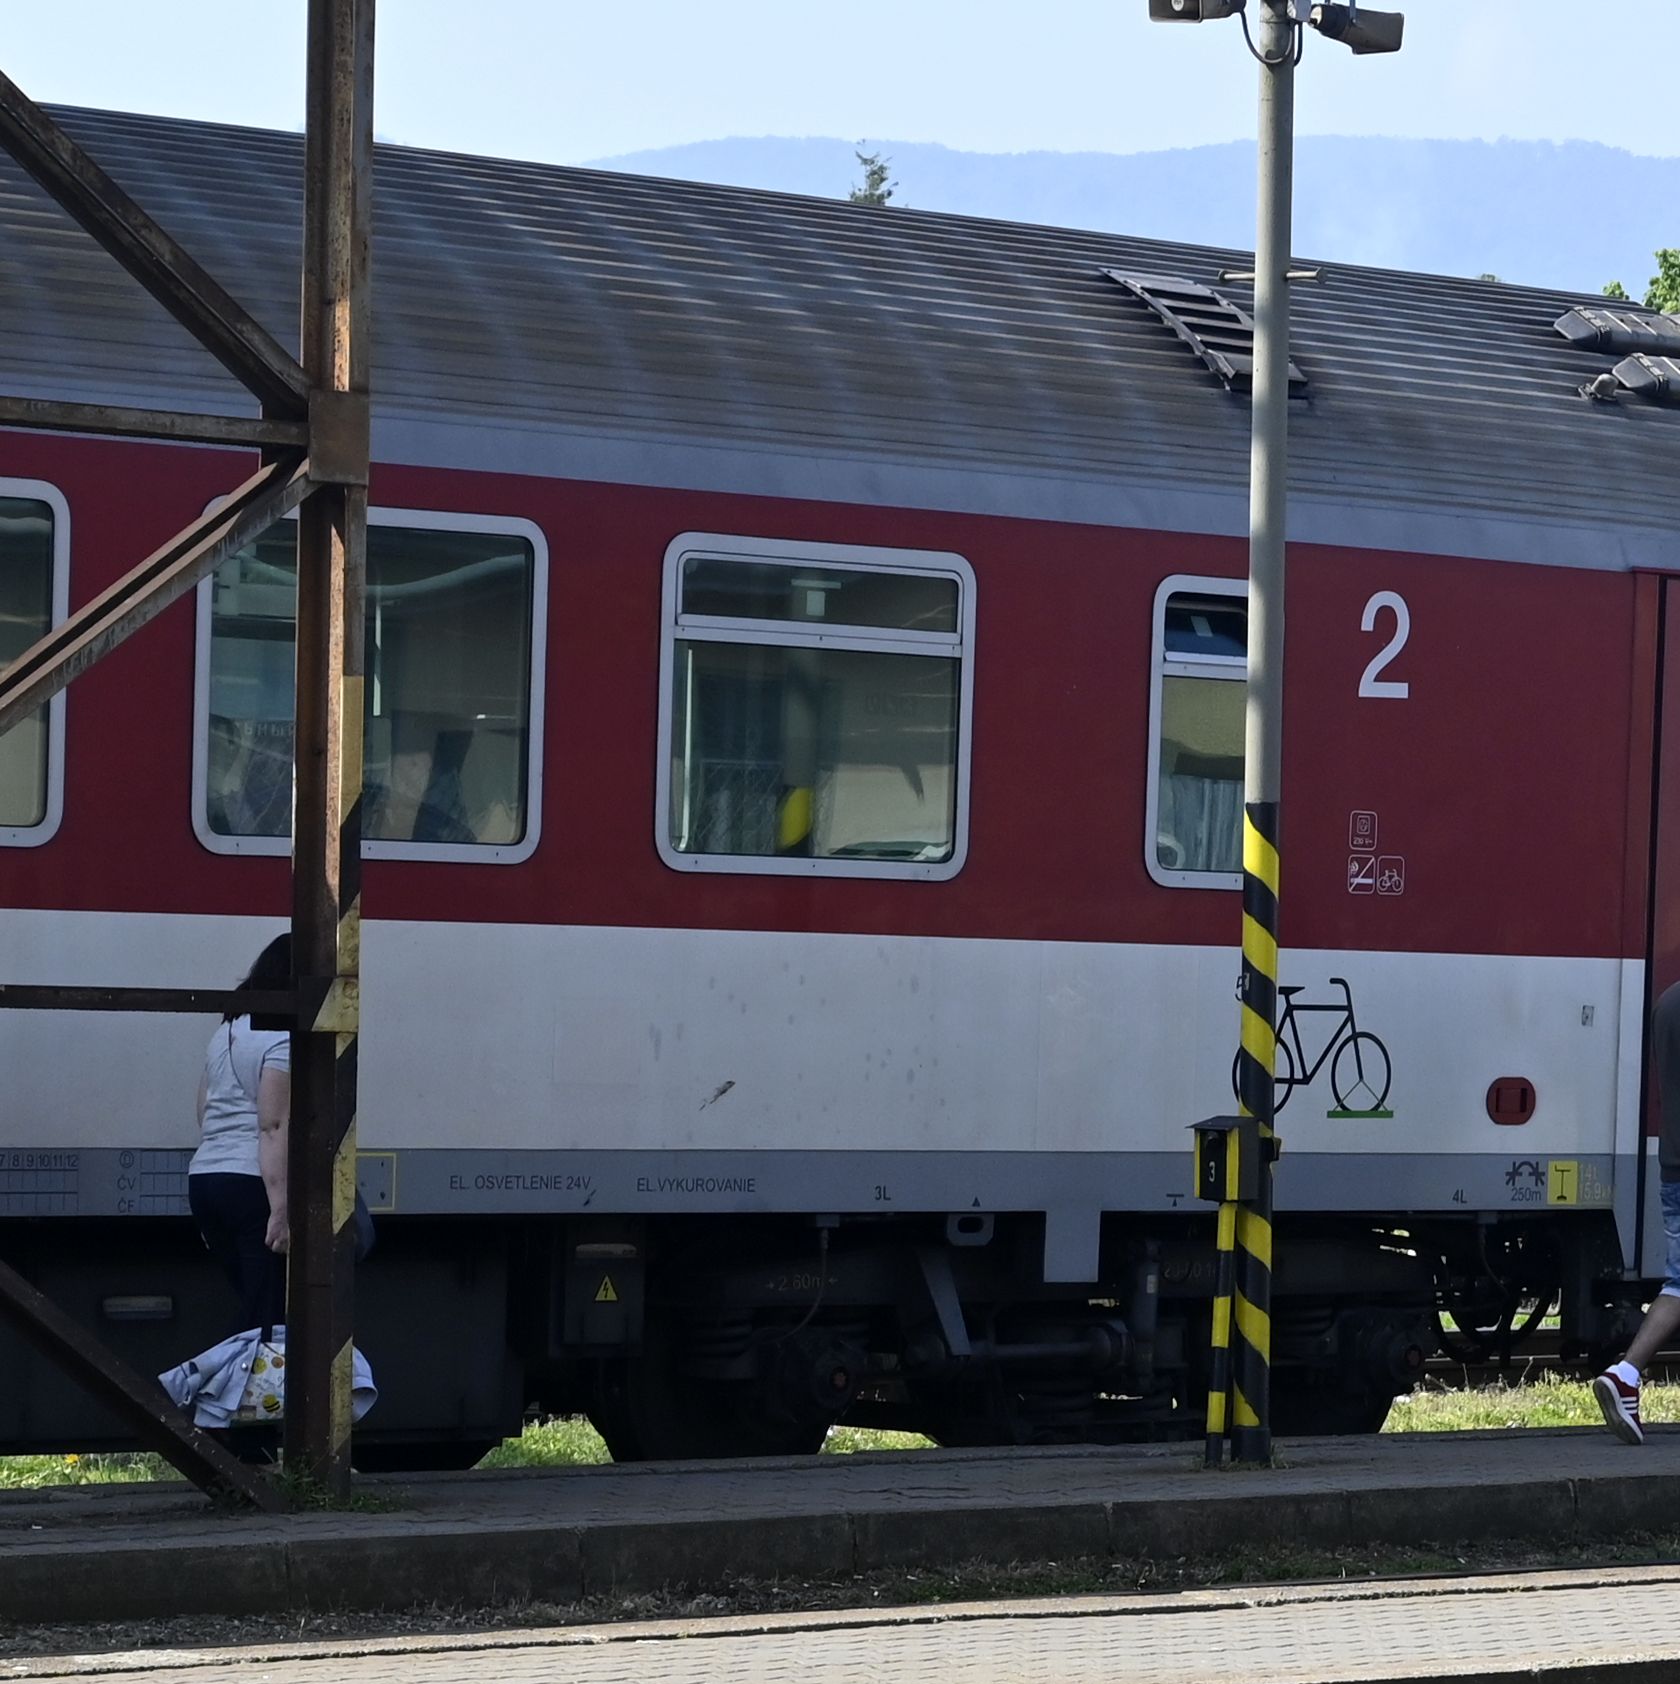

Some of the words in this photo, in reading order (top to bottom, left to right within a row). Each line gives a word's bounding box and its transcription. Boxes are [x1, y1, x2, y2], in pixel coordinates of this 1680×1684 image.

[1358, 590, 1410, 699] 2
[12, 1154, 20, 1167] 8
[26, 1154, 34, 1167] 9
[38, 1154, 51, 1168] 10
[67, 1155, 79, 1168] 12
[1208, 1160, 1216, 1183] 3
[474, 1175, 562, 1191] OSVETLENIE
[565, 1176, 592, 1191] 24V
[874, 1185, 891, 1201] 3L
[1452, 1189, 1468, 1204] 4L
[1510, 1187, 1542, 1202] 250m
